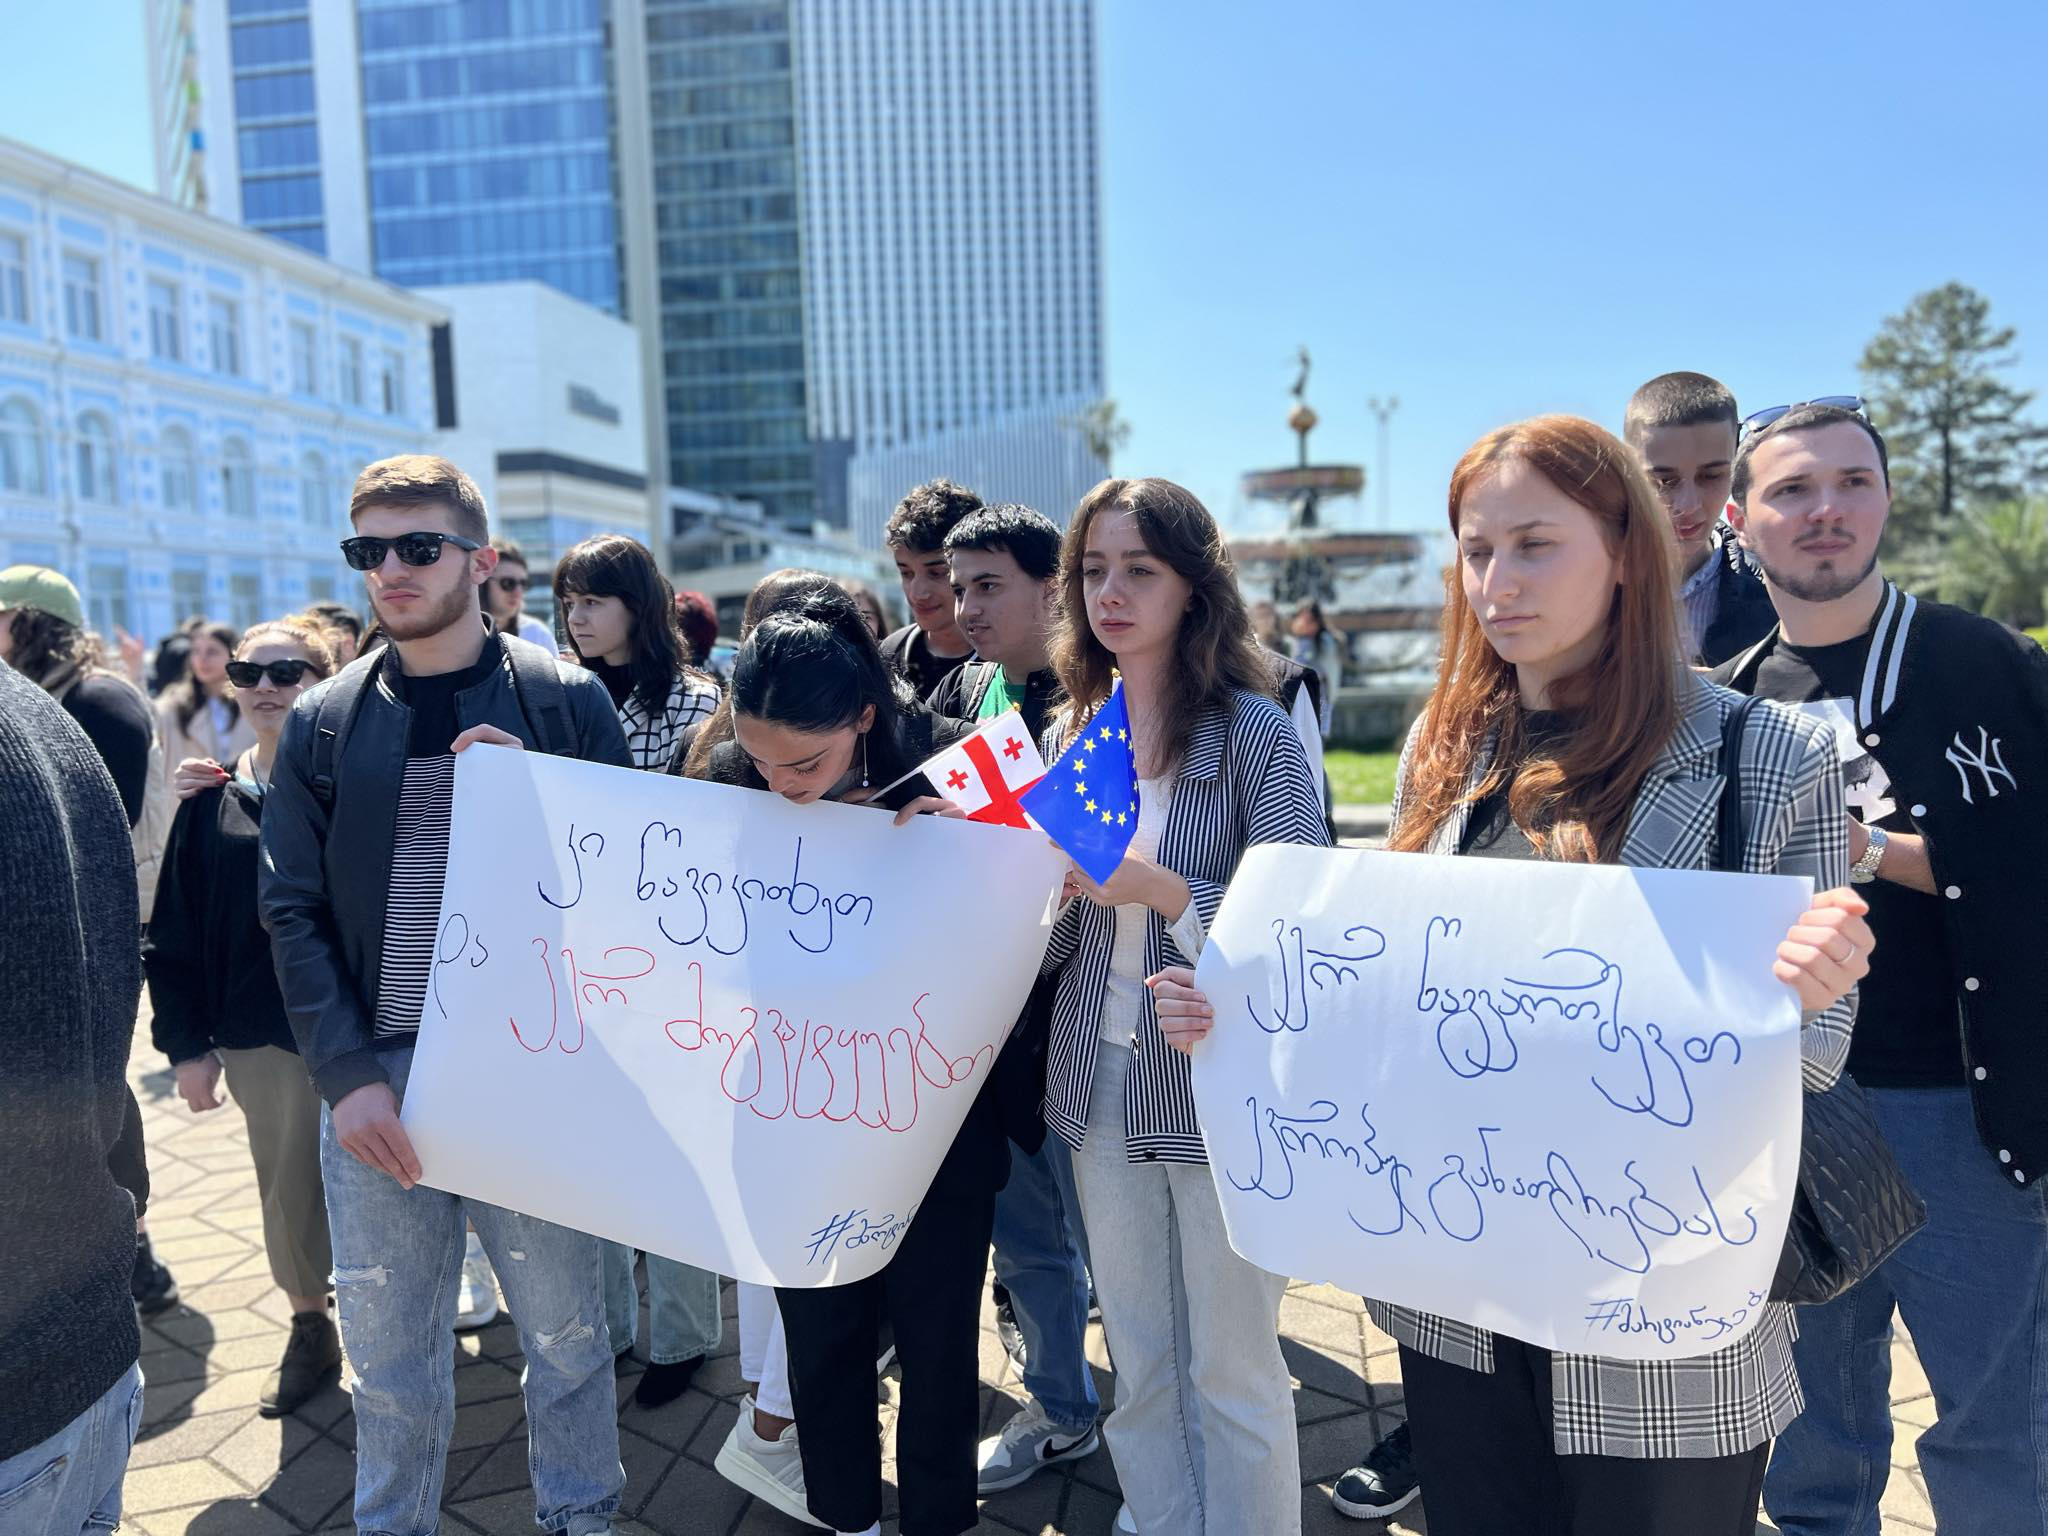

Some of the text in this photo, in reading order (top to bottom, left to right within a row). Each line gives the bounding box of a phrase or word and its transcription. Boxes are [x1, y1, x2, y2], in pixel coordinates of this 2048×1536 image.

[1945, 725, 2017, 804] NY
[538, 824, 604, 909] კი
[433, 913, 489, 1020] და
[510, 938, 656, 1054] ვერ
[1247, 919, 1386, 1033] ვერ
